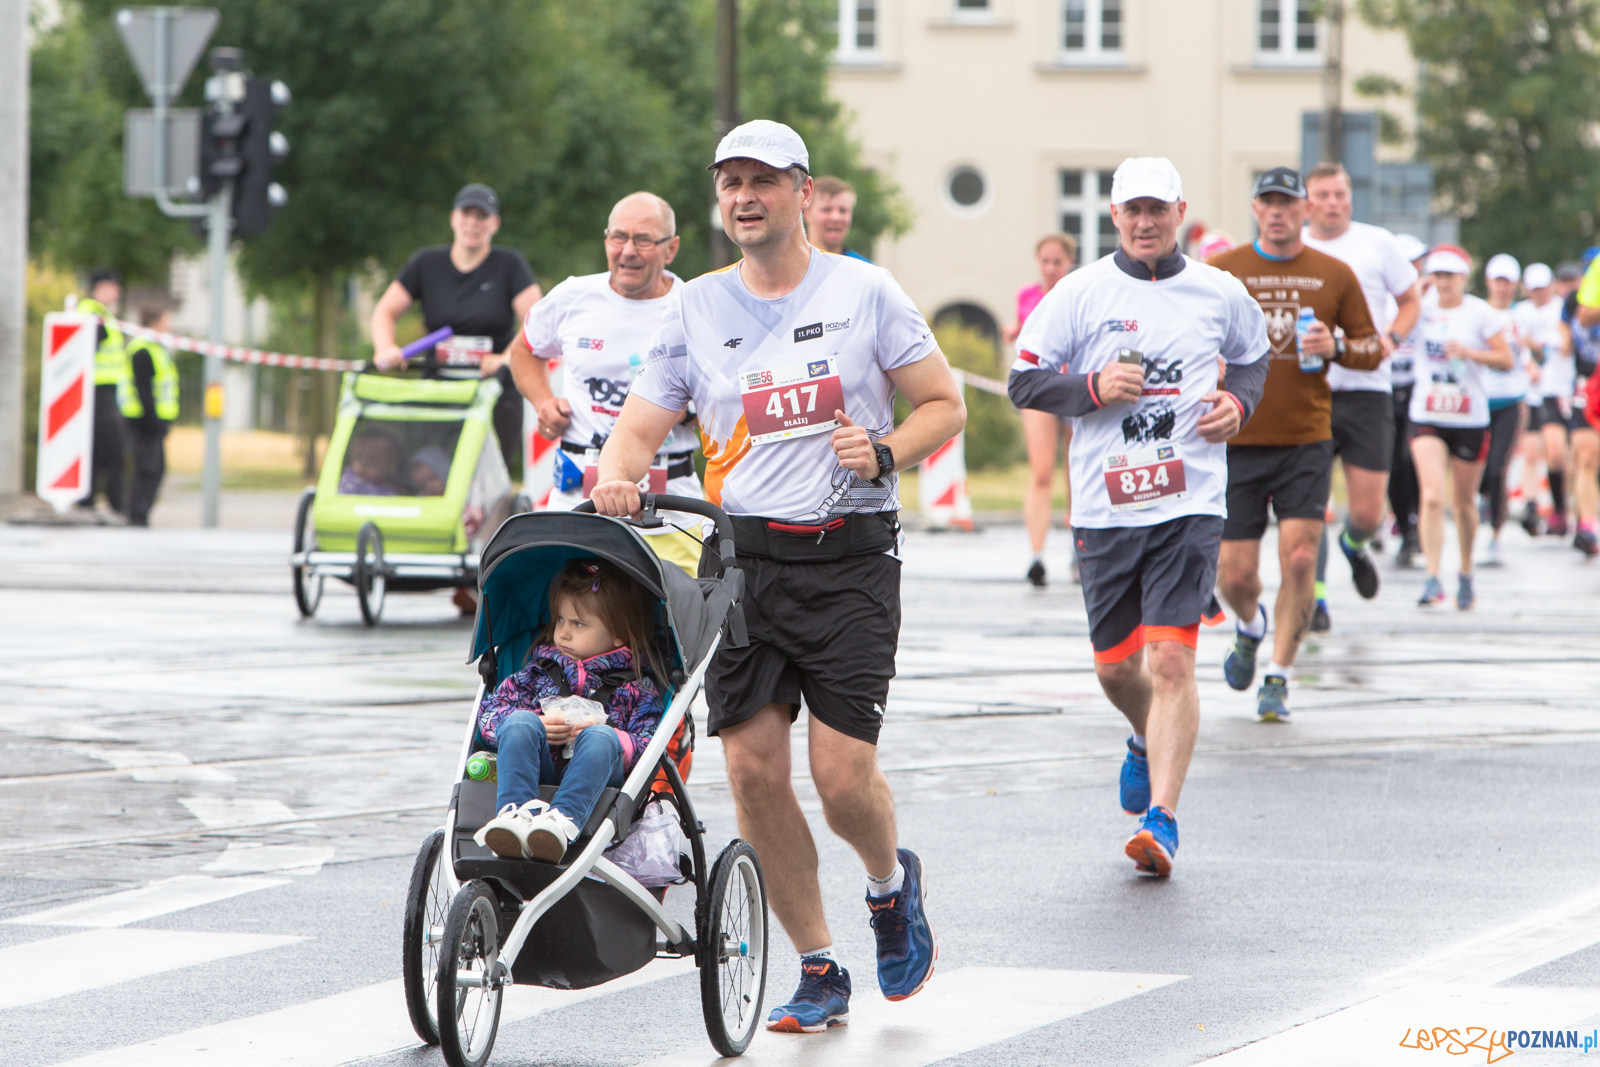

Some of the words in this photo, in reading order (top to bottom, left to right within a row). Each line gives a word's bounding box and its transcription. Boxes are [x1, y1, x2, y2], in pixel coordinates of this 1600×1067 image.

[806, 326, 821, 337] PKO
[723, 338, 744, 348] 4F
[765, 383, 819, 419] 417
[783, 416, 809, 428] BŁAŻEJ
[1119, 464, 1170, 495] 824
